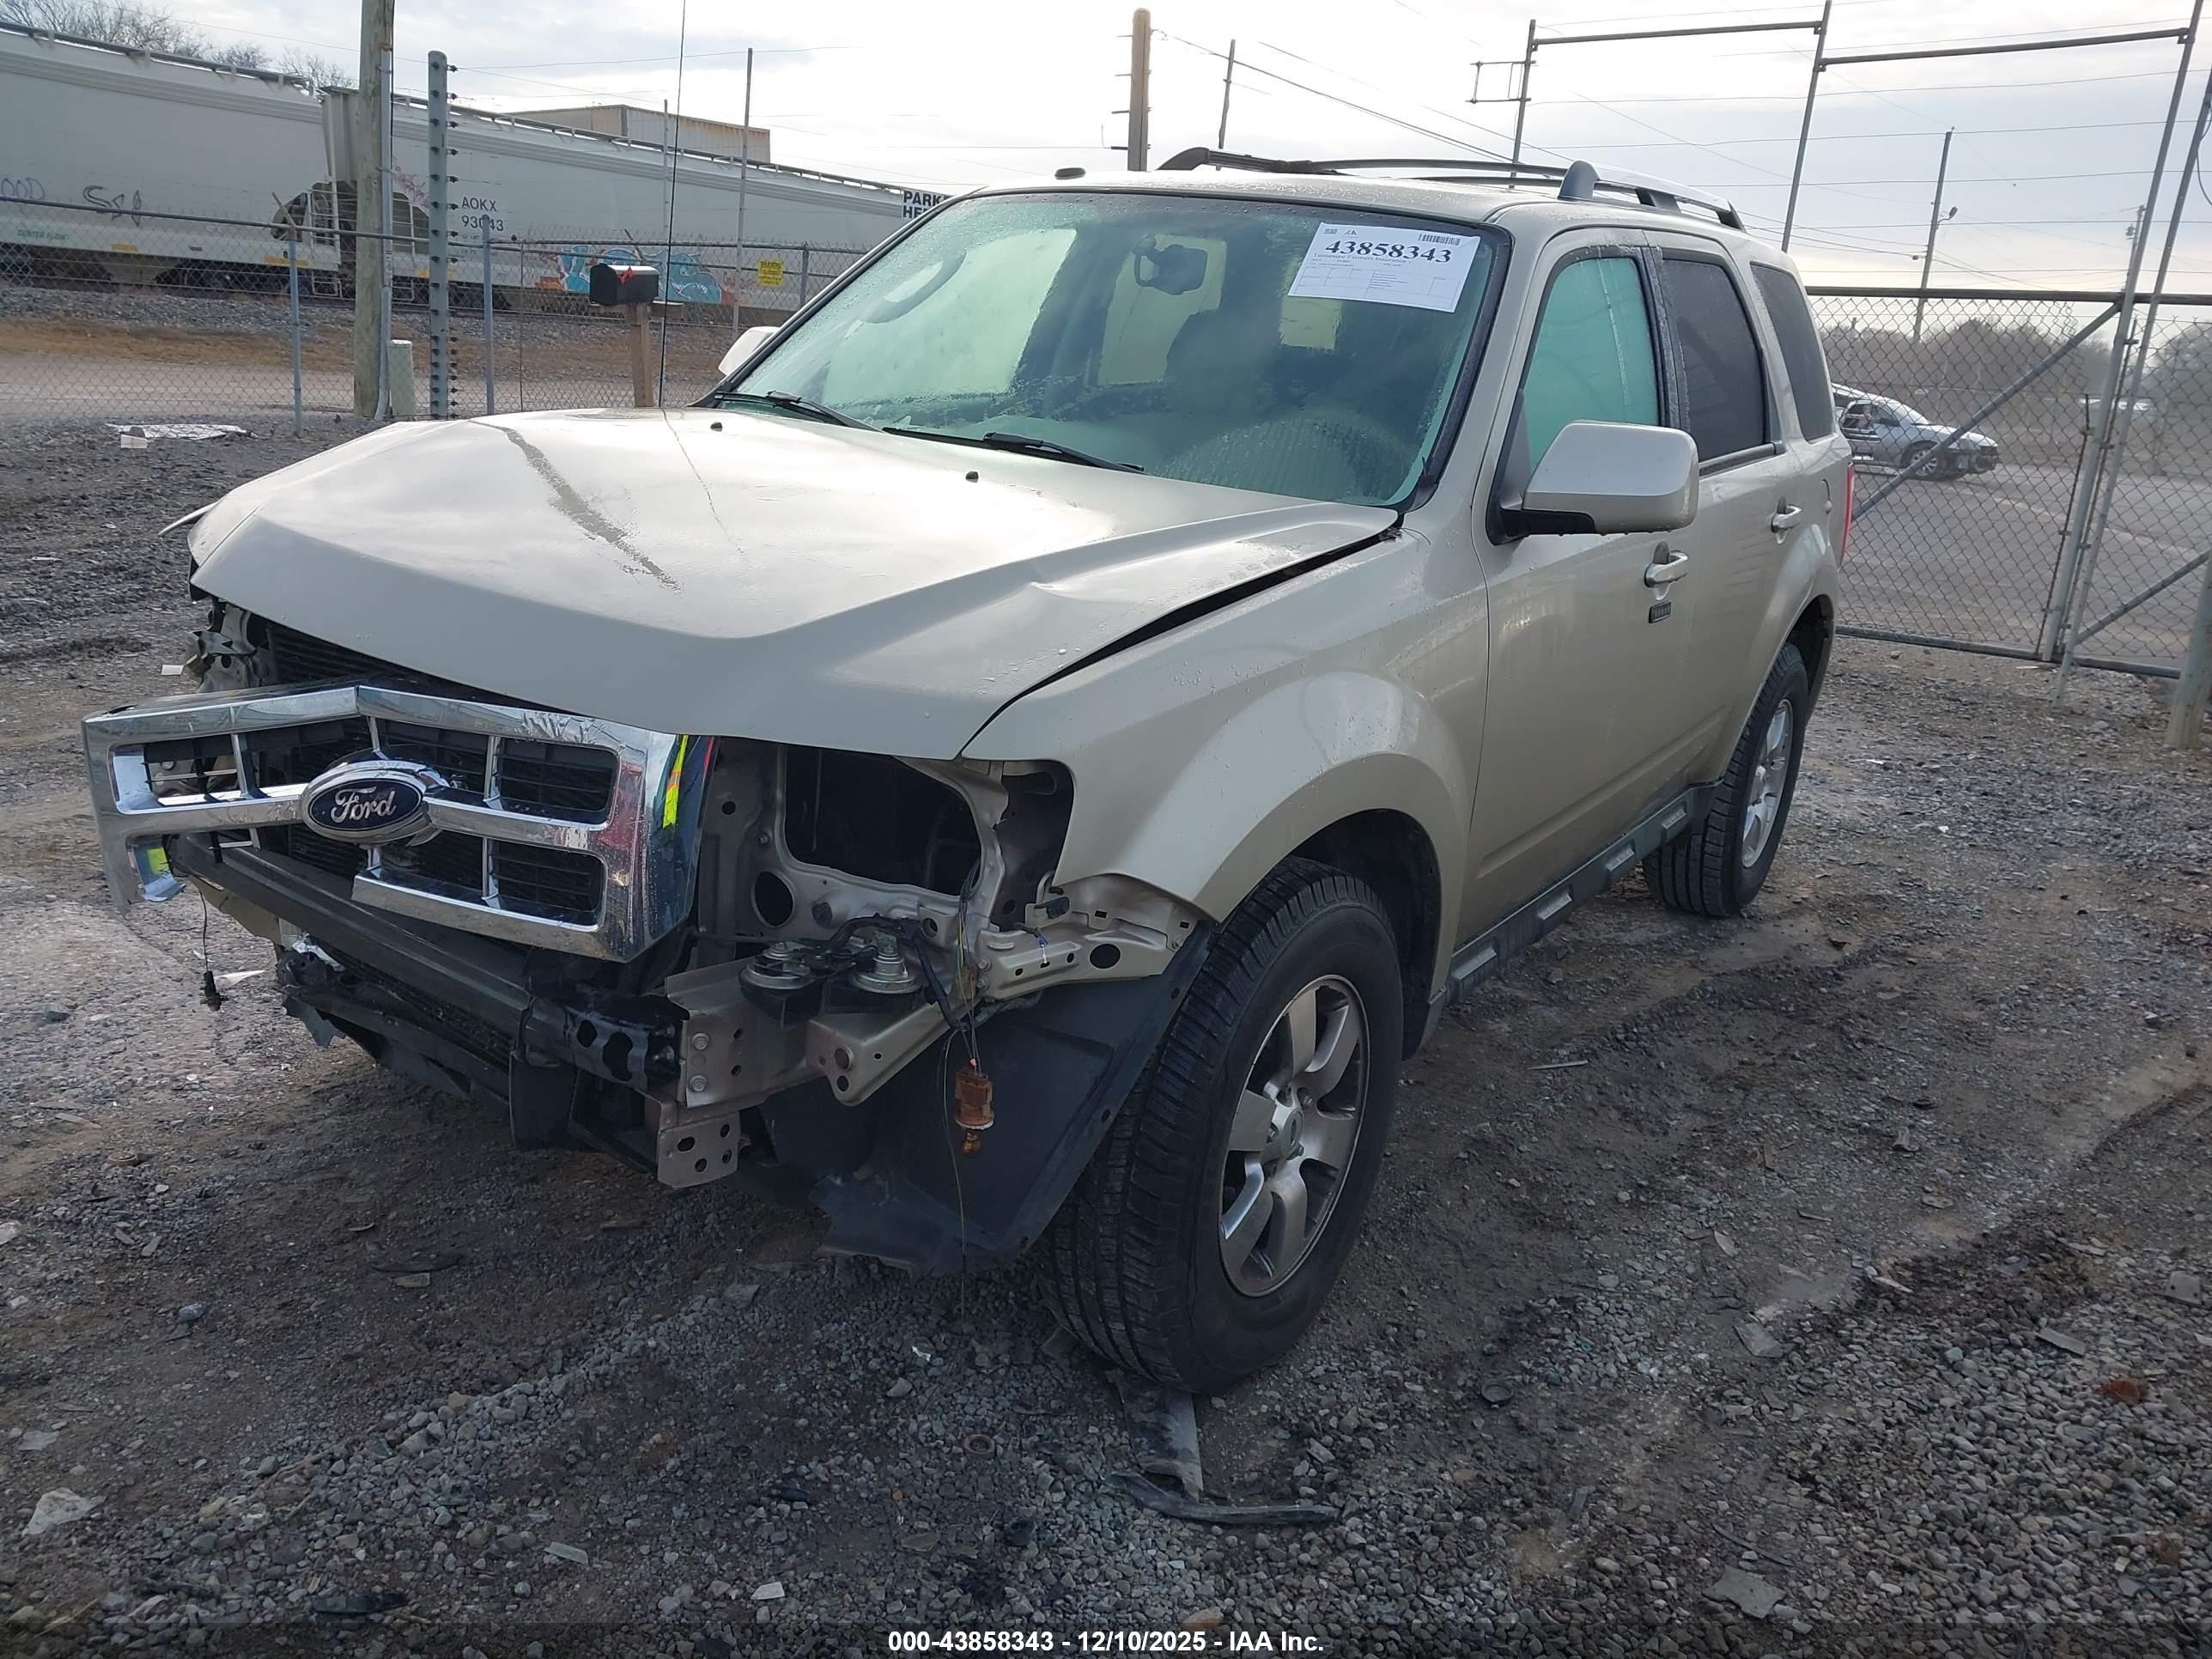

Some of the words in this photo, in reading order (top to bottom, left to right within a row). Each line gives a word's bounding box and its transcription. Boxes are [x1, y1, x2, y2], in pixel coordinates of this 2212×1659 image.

[462, 197, 497, 212] AOKX
[902, 204, 927, 219] HE
[1325, 240, 1451, 263] 43858343
[331, 786, 397, 823] Ford
